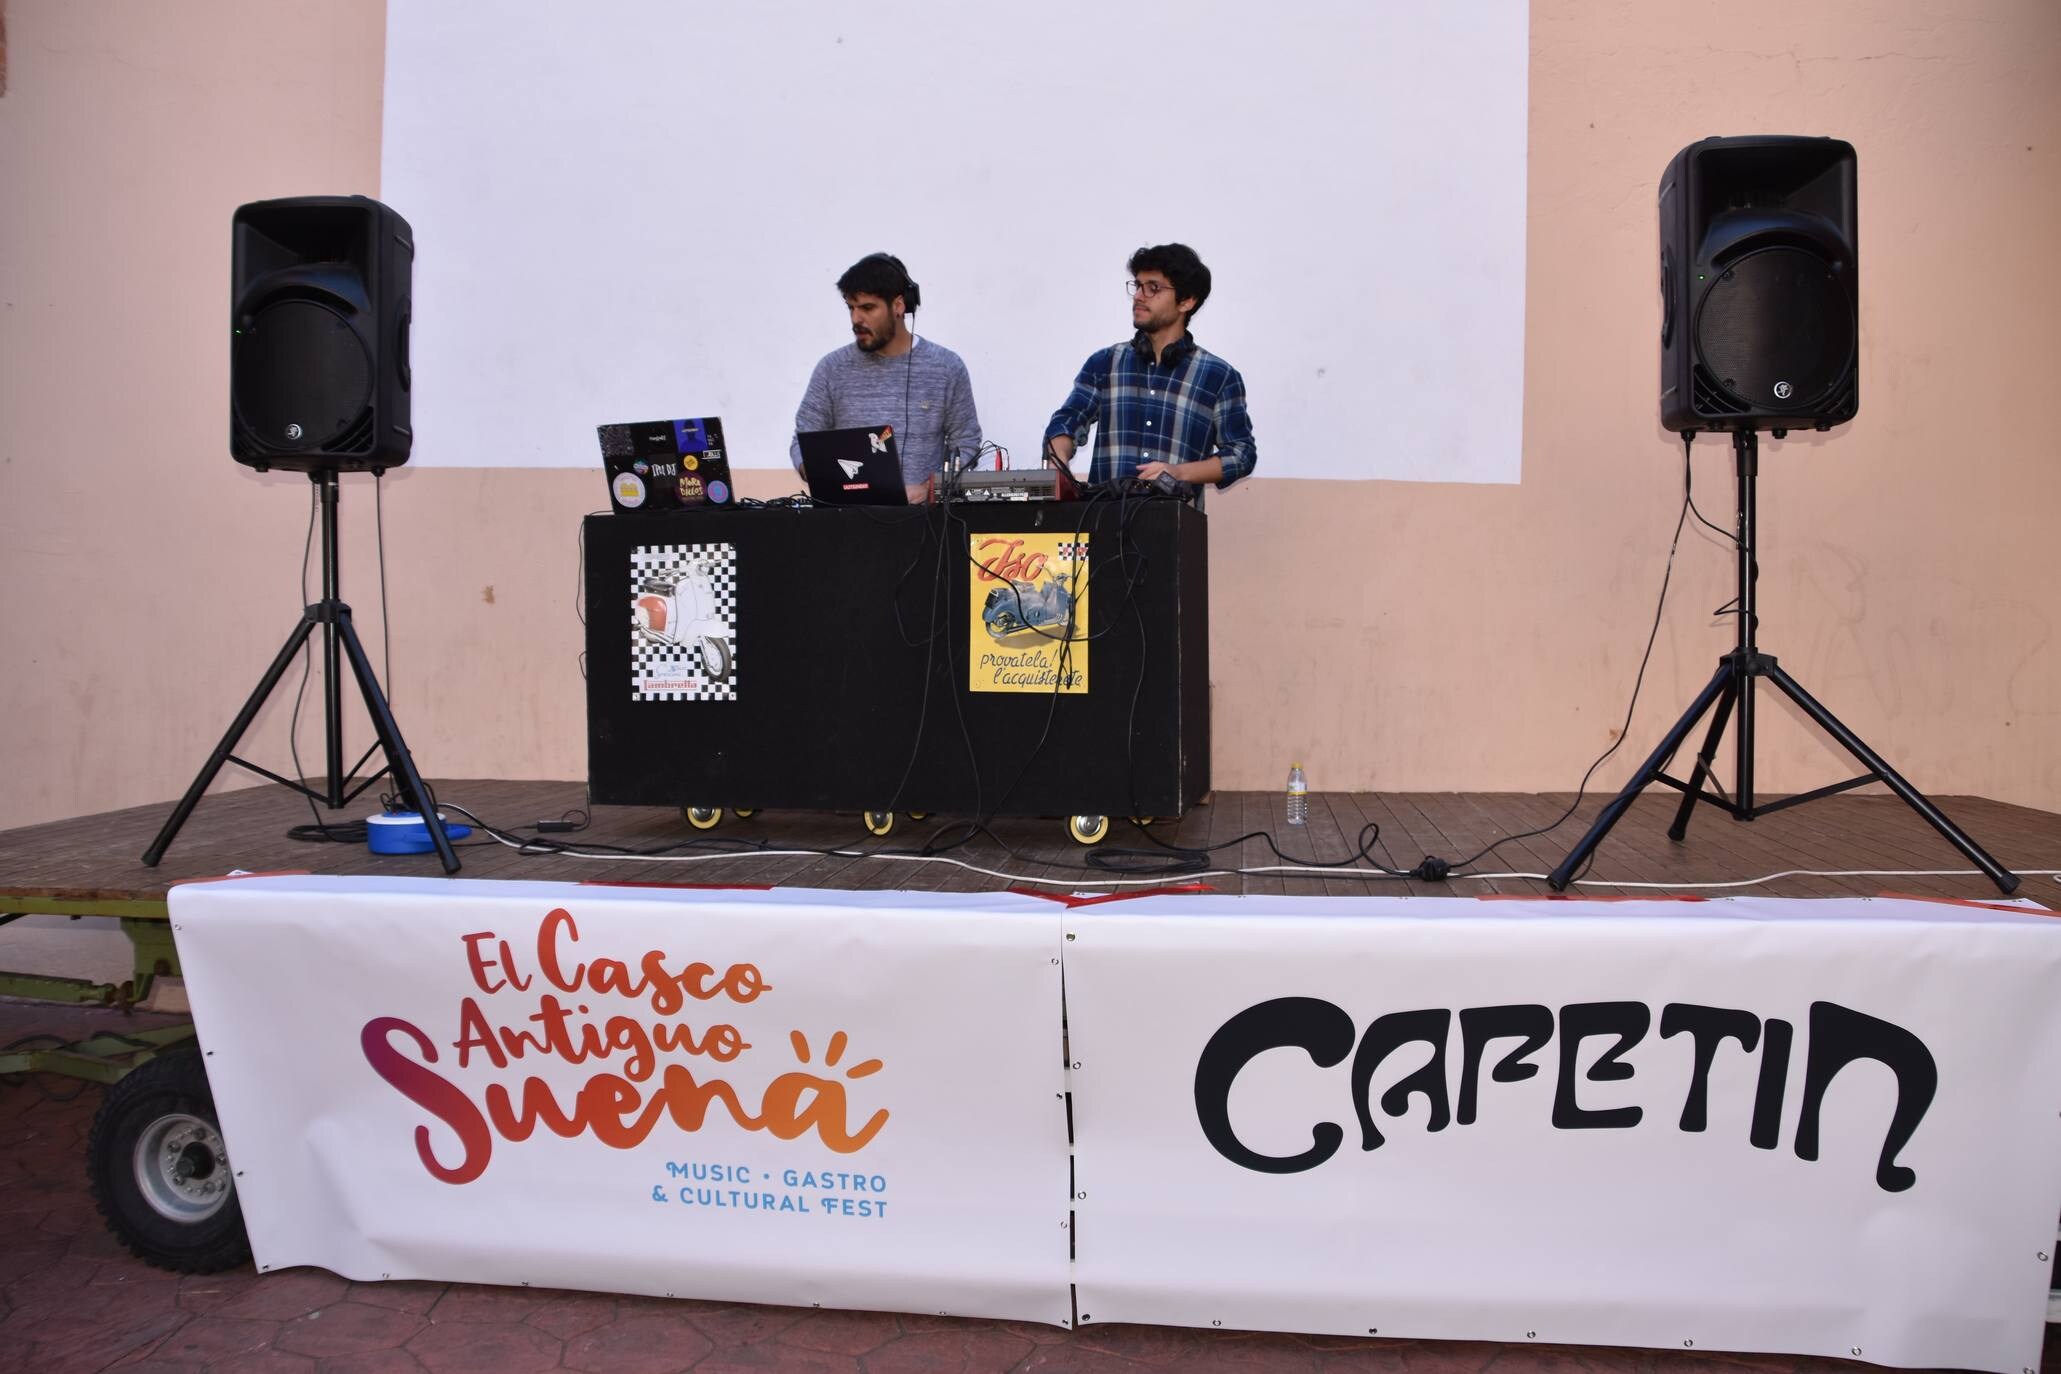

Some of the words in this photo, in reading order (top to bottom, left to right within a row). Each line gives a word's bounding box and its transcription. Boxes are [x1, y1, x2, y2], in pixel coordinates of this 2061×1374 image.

[461, 931, 532, 994] El
[537, 908, 773, 1016] Casco
[452, 995, 752, 1083] Antiguo
[360, 1017, 890, 1185] Suena
[652, 1184, 669, 1203] &
[679, 1187, 810, 1213] CULTURAL
[821, 1198, 888, 1218] FEST
[666, 1162, 750, 1184] MUSIC
[783, 1169, 887, 1193] GASTRO
